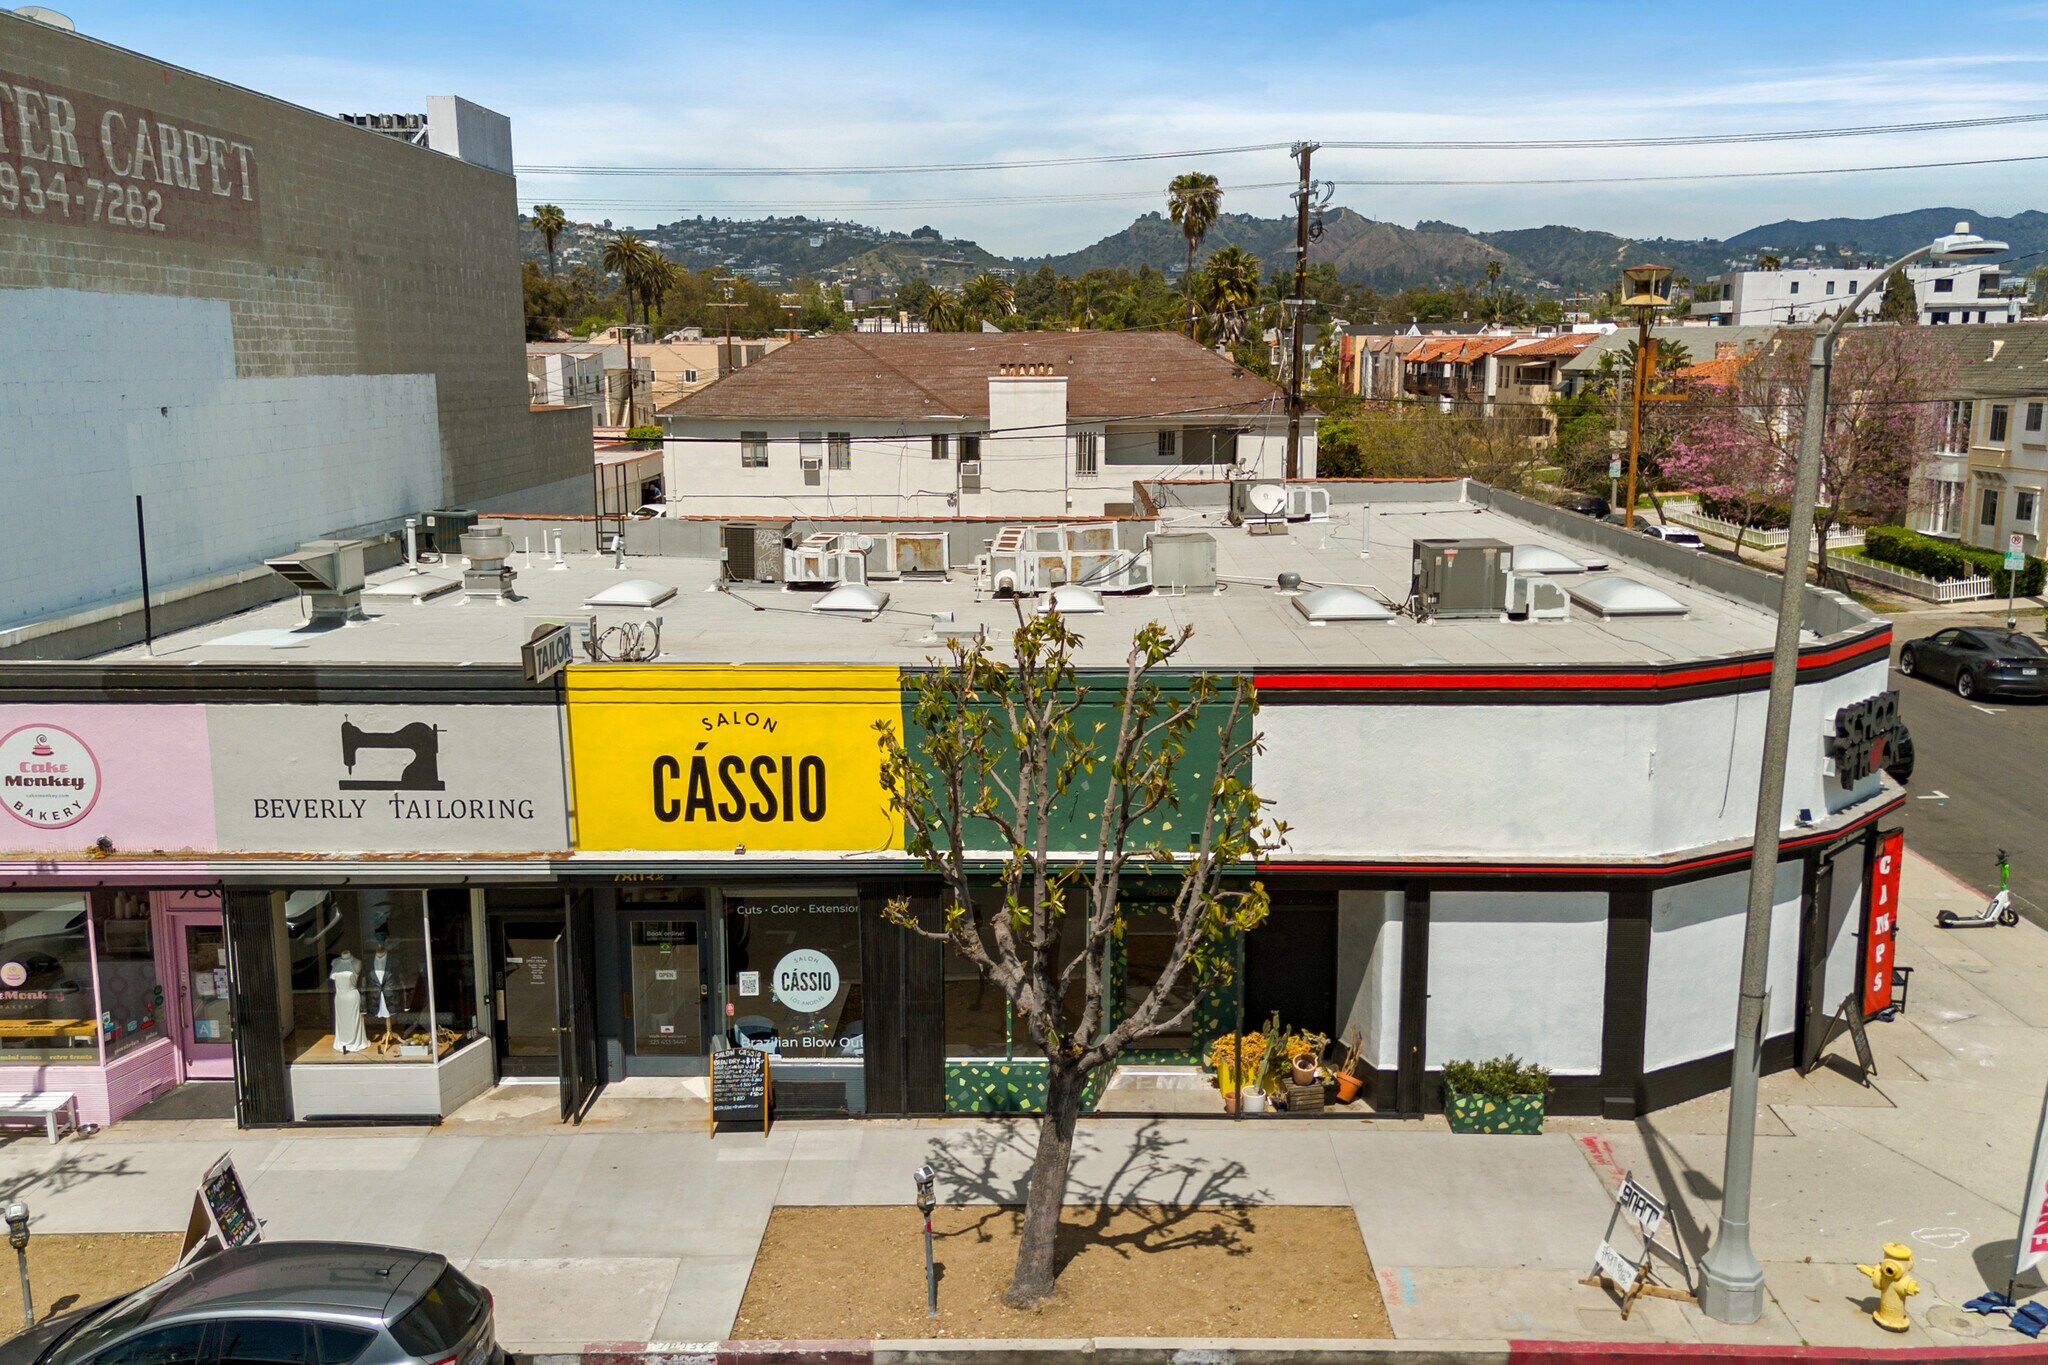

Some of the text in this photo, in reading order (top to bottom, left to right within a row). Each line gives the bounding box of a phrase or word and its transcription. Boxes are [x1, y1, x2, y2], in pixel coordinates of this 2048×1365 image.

[101, 110, 256, 201] CARPET
[702, 711, 778, 733] SALON
[1841, 690, 1901, 743] SCHOOL
[1858, 727, 1901, 780] ROCK
[19, 761, 70, 773] Cake
[5, 775, 86, 791] Monkey
[653, 742, 827, 822] CÁSSIO
[13, 800, 82, 821] BAKERY
[254, 793, 534, 819] BEVERLY TAILORING
[737, 905, 763, 915] Cuts
[771, 904, 800, 914] Color
[793, 955, 820, 964] SALON
[781, 968, 832, 992] CÁSSIO
[789, 995, 825, 1006] LOS ANGELES
[741, 1037, 864, 1048] Brazilian Blow Out
[714, 1050, 735, 1059] SALON
